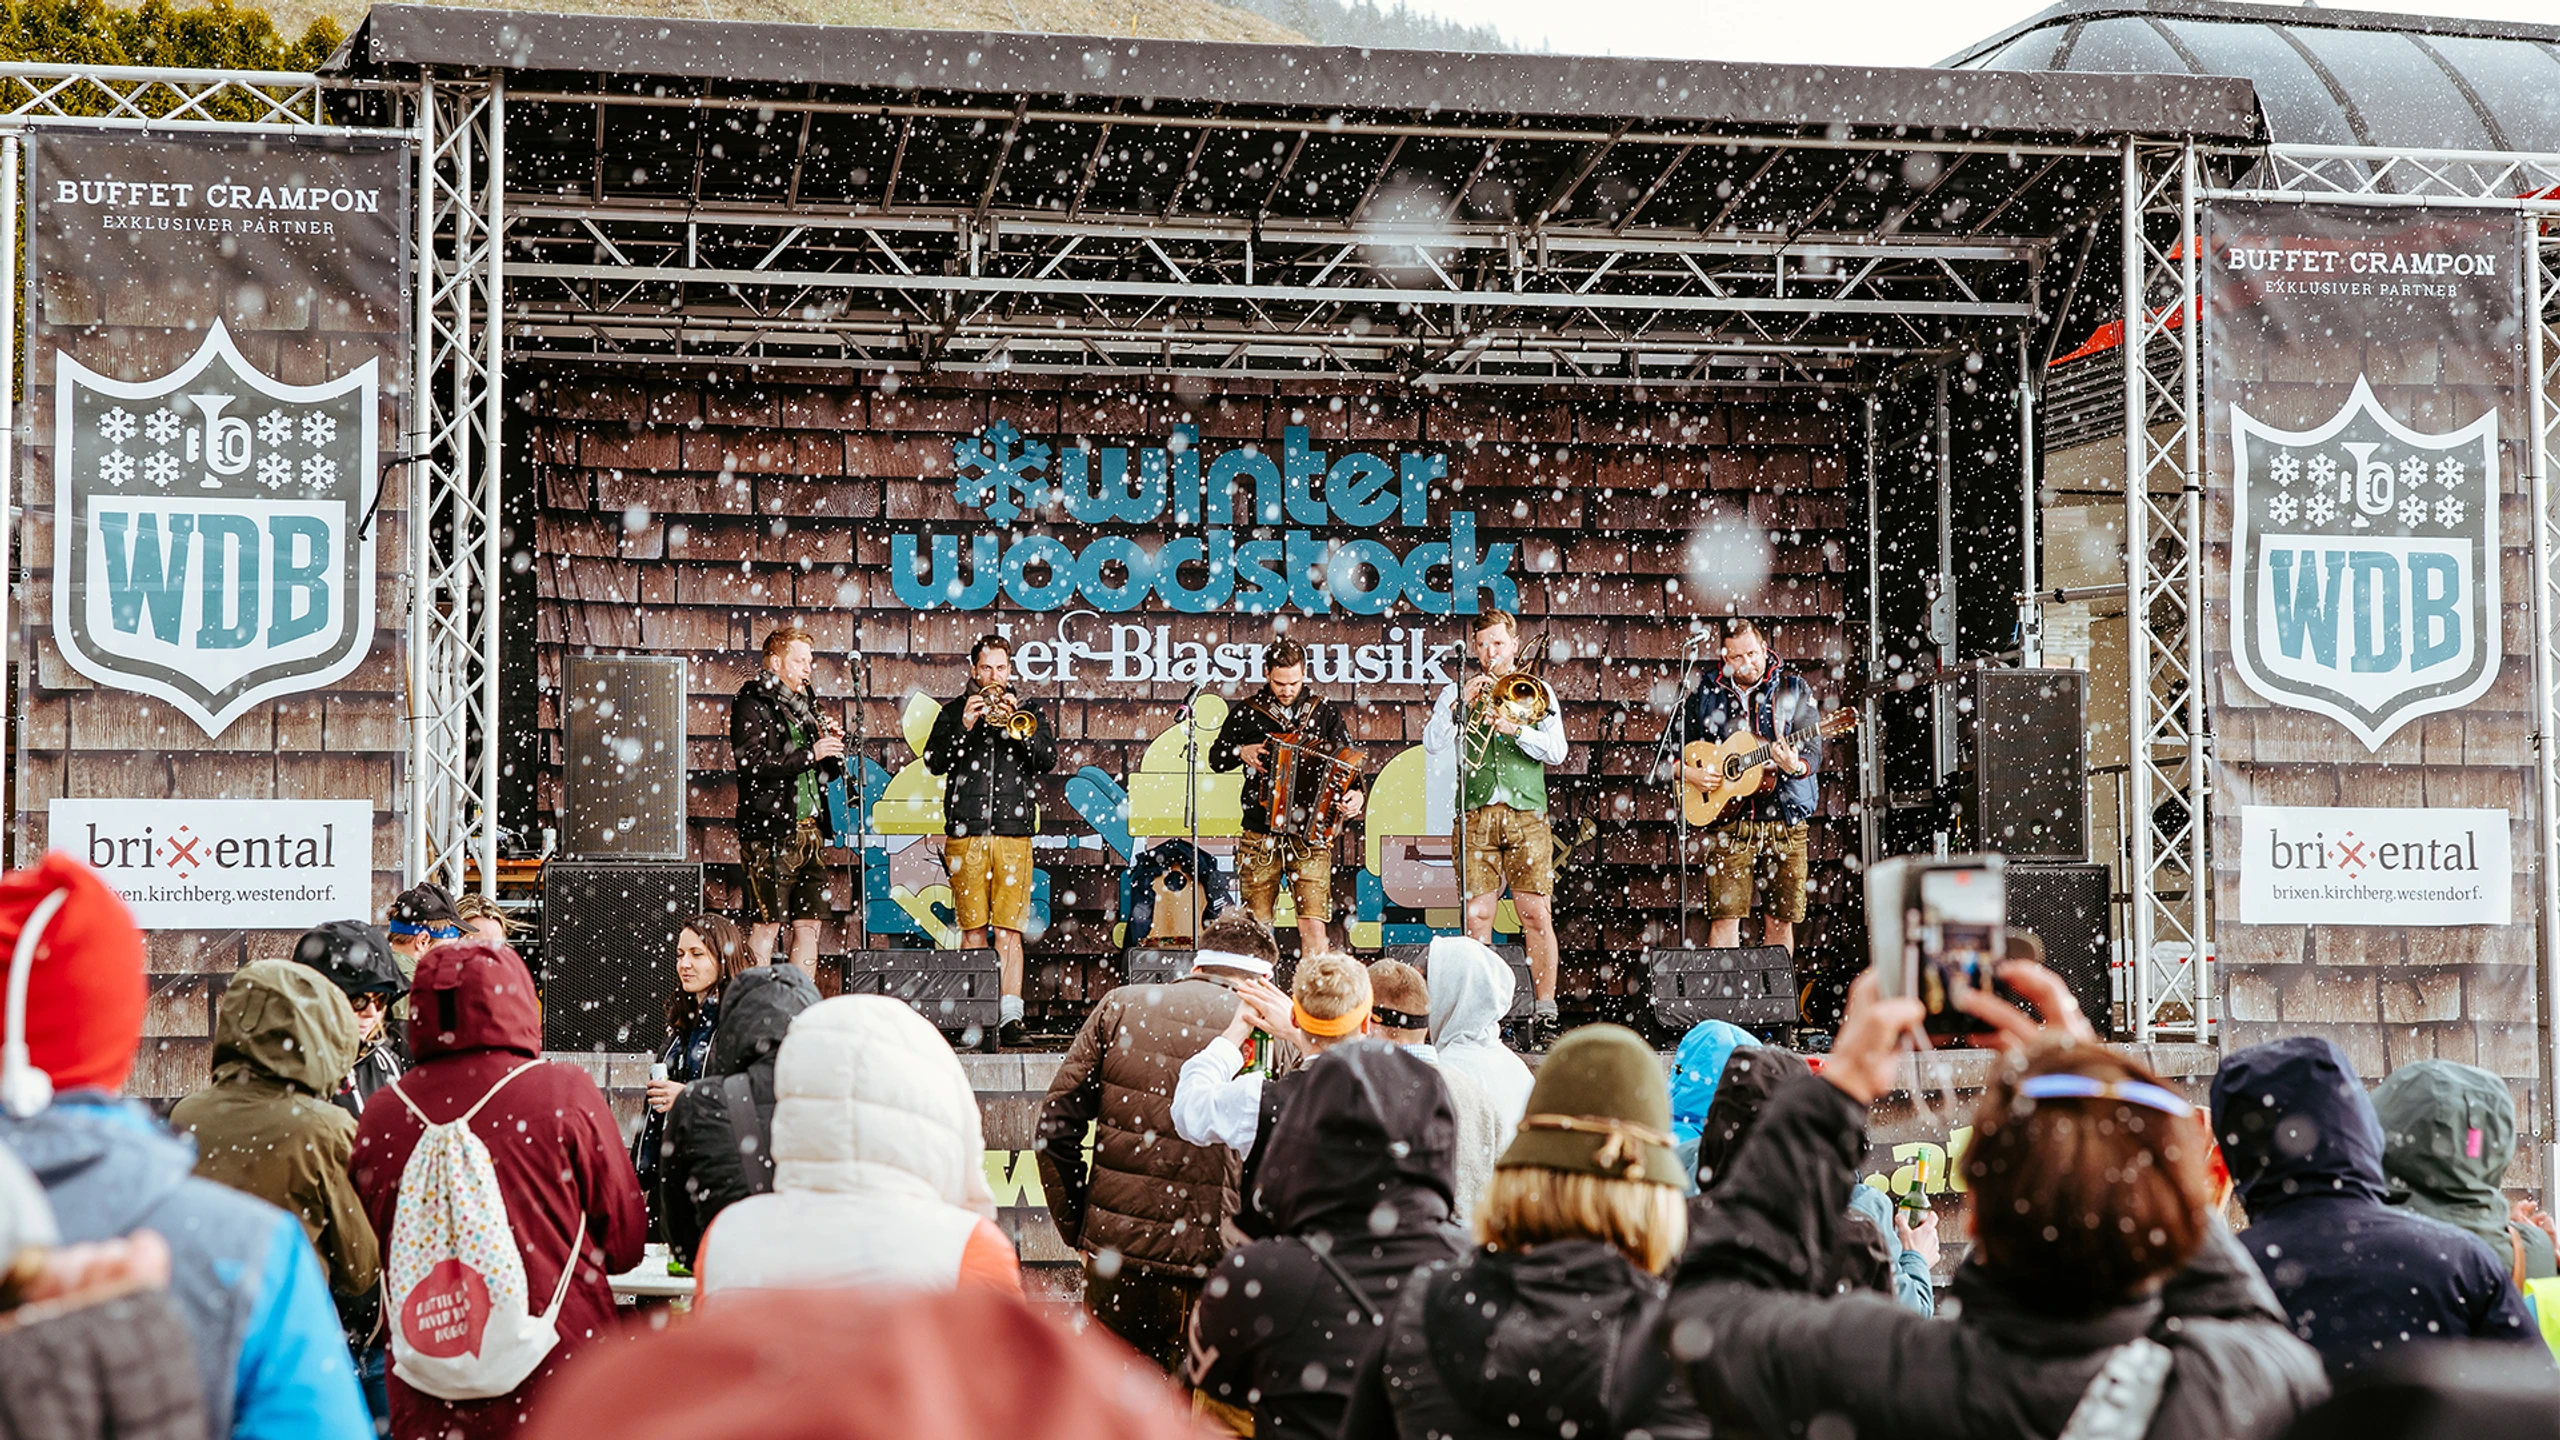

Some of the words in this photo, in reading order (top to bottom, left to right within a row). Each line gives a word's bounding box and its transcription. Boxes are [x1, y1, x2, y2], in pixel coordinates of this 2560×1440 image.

[57, 180, 194, 208] BUFFET
[206, 185, 380, 214] CRAMPON
[102, 216, 233, 233] EXKLUSIVER
[242, 219, 335, 235] PARTNER
[2228, 248, 2339, 273] BUFFET
[2350, 251, 2496, 276] CRAMPON
[2265, 280, 2372, 296] EXKLUSIVER
[2380, 283, 2457, 298] PARTNER
[1060, 423, 1447, 526] winter
[891, 511, 1518, 614] woodstock
[99, 511, 331, 649] WDB
[2269, 549, 2463, 673] WDB
[114, 884, 336, 905] xen.kirchberg.westendorf.
[2273, 884, 2484, 904] brixen.kirchberg.westendorf.
